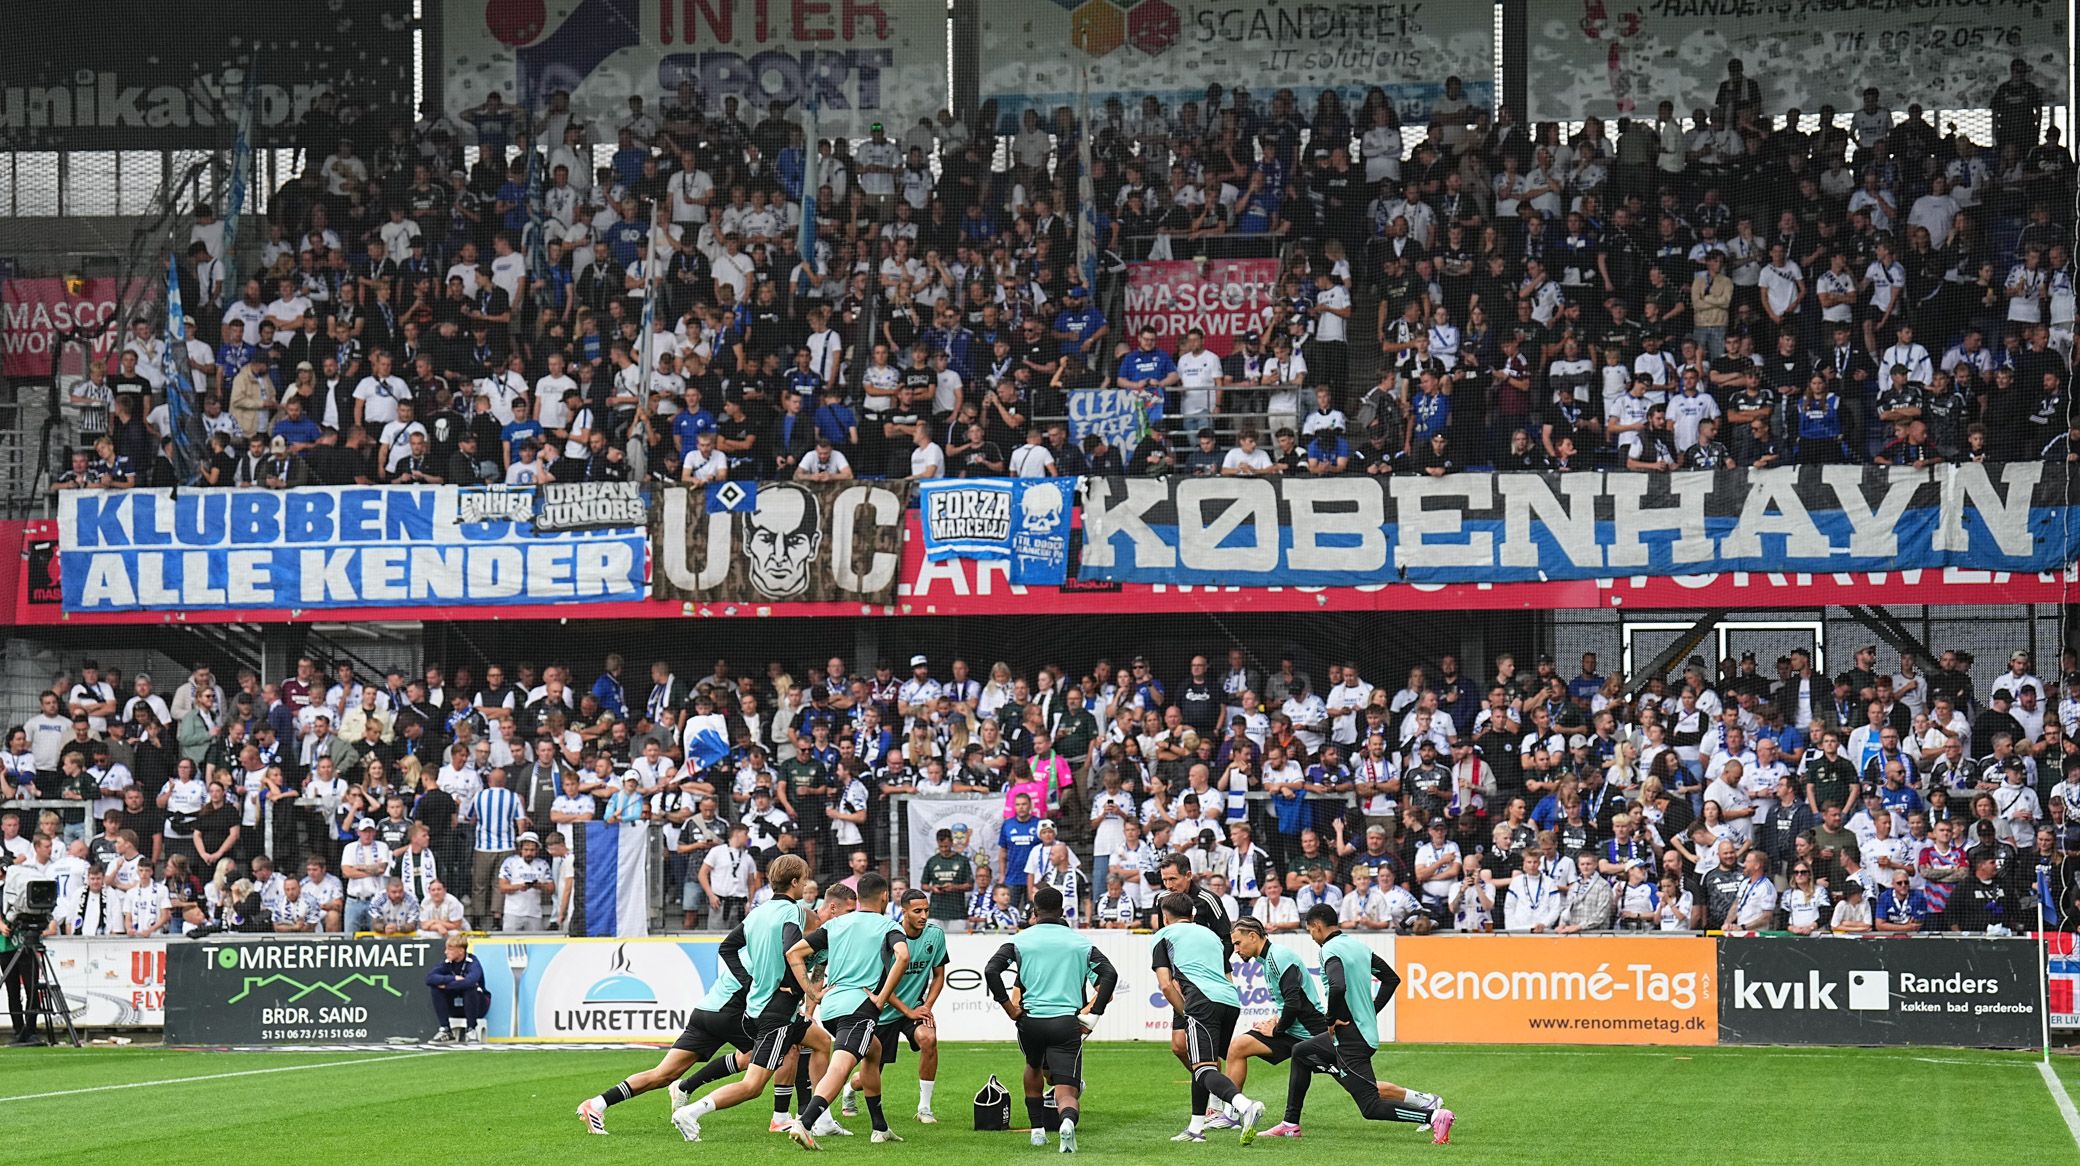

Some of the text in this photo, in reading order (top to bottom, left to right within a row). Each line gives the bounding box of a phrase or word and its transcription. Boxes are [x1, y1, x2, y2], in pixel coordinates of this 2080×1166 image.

[658, 48, 893, 113] SPORT
[545, 482, 640, 503] URBAN
[540, 498, 645, 527] JUNIORS
[930, 490, 1010, 520] FORZA
[77, 490, 438, 547] KLUBBEN
[1081, 461, 2046, 573] KØBENHAVN
[932, 519, 1009, 541] MARCELLO
[81, 541, 636, 607] ALLE KENDER
[1406, 962, 1697, 1010] Renommé-Tag
[1900, 972, 1999, 995] Randers
[262, 1006, 369, 1026] BRDR. SAND
[554, 1009, 686, 1031] LIVRETTEN
[1900, 1001, 2034, 1016] køkken bad garderobe
[262, 1029, 273, 1040] 51
[274, 1029, 286, 1040] 51
[287, 1029, 299, 1040] 06
[300, 1029, 311, 1040] 73
[318, 1029, 329, 1040] 51
[331, 1029, 342, 1040] 51
[343, 1029, 355, 1040] 05
[356, 1029, 367, 1040] 60
[1528, 1015, 1706, 1033] www.renommetag.dk
